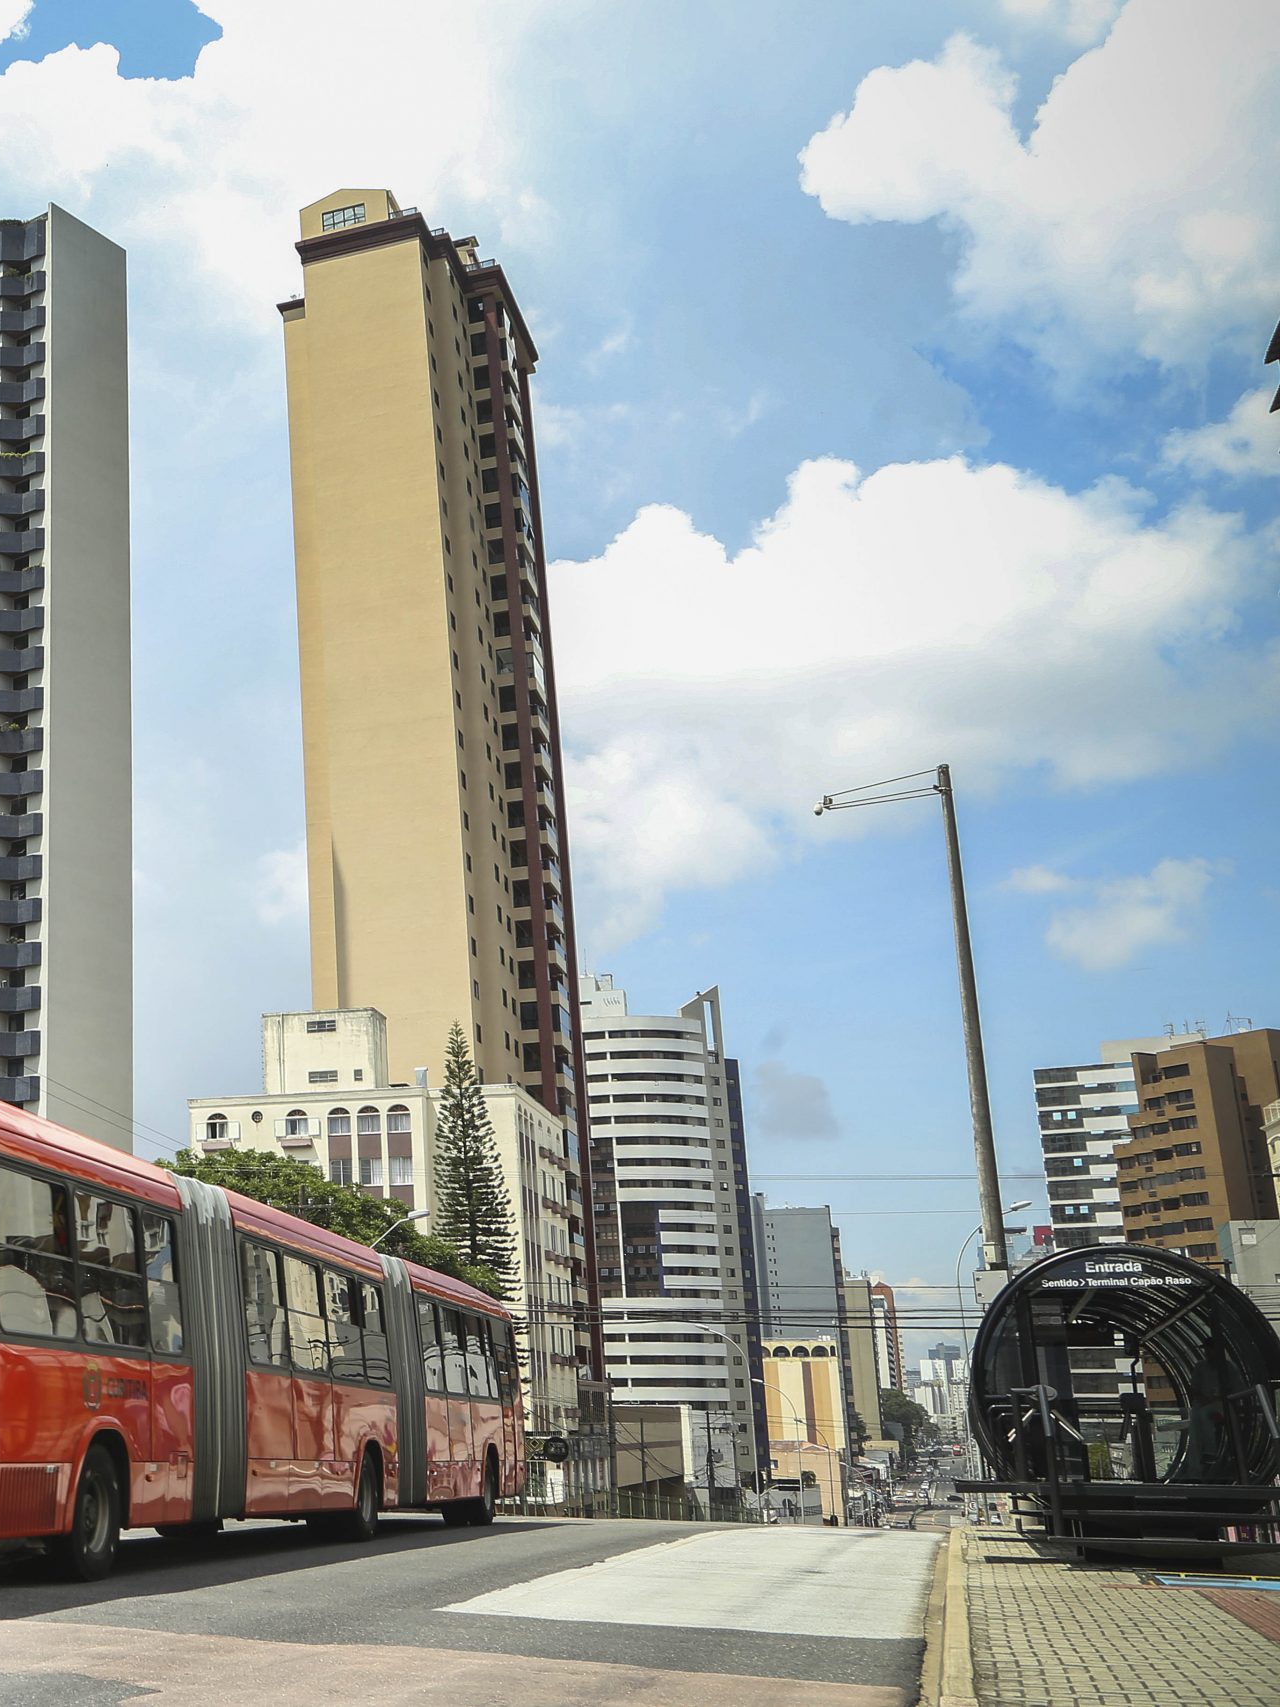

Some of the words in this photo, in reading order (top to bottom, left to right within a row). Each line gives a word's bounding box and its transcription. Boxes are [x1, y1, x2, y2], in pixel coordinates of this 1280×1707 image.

[1085, 1261, 1143, 1273] Entrada
[1041, 1278, 1079, 1288] Sentido
[1086, 1278, 1128, 1287] Terminal
[1130, 1276, 1163, 1287] Capão
[1165, 1276, 1192, 1285] Raso
